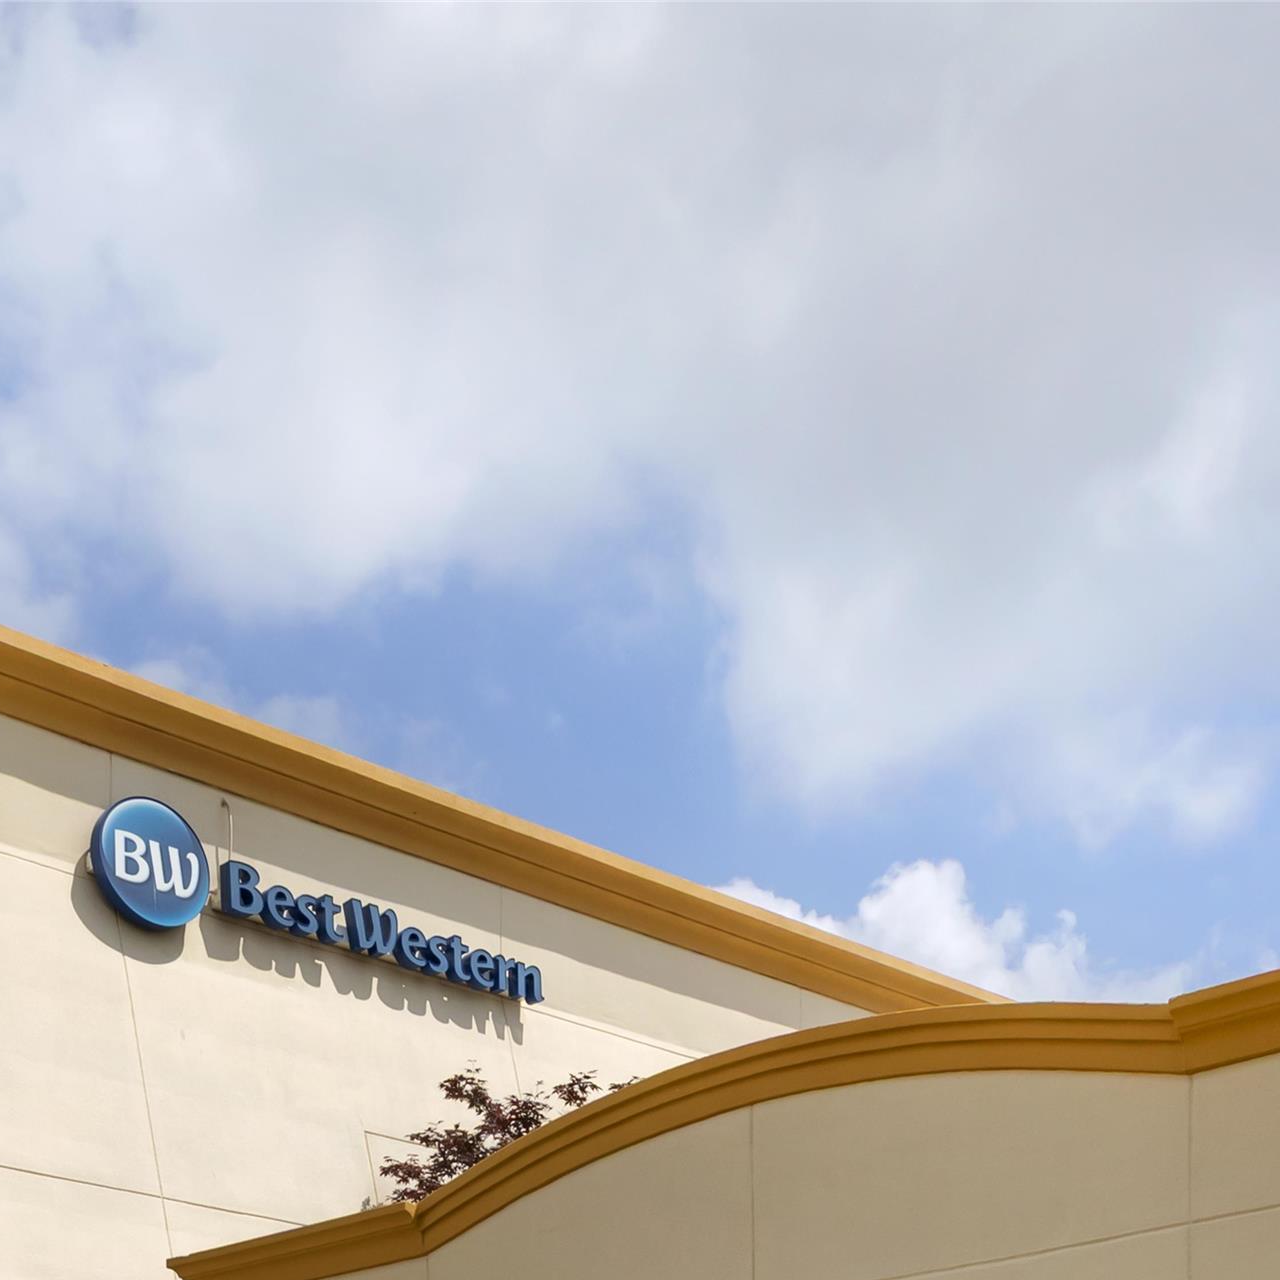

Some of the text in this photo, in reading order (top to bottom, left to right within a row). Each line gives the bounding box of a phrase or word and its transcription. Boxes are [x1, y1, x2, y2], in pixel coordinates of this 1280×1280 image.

[113, 828, 200, 899] BW
[220, 860, 546, 1005] Best Western
